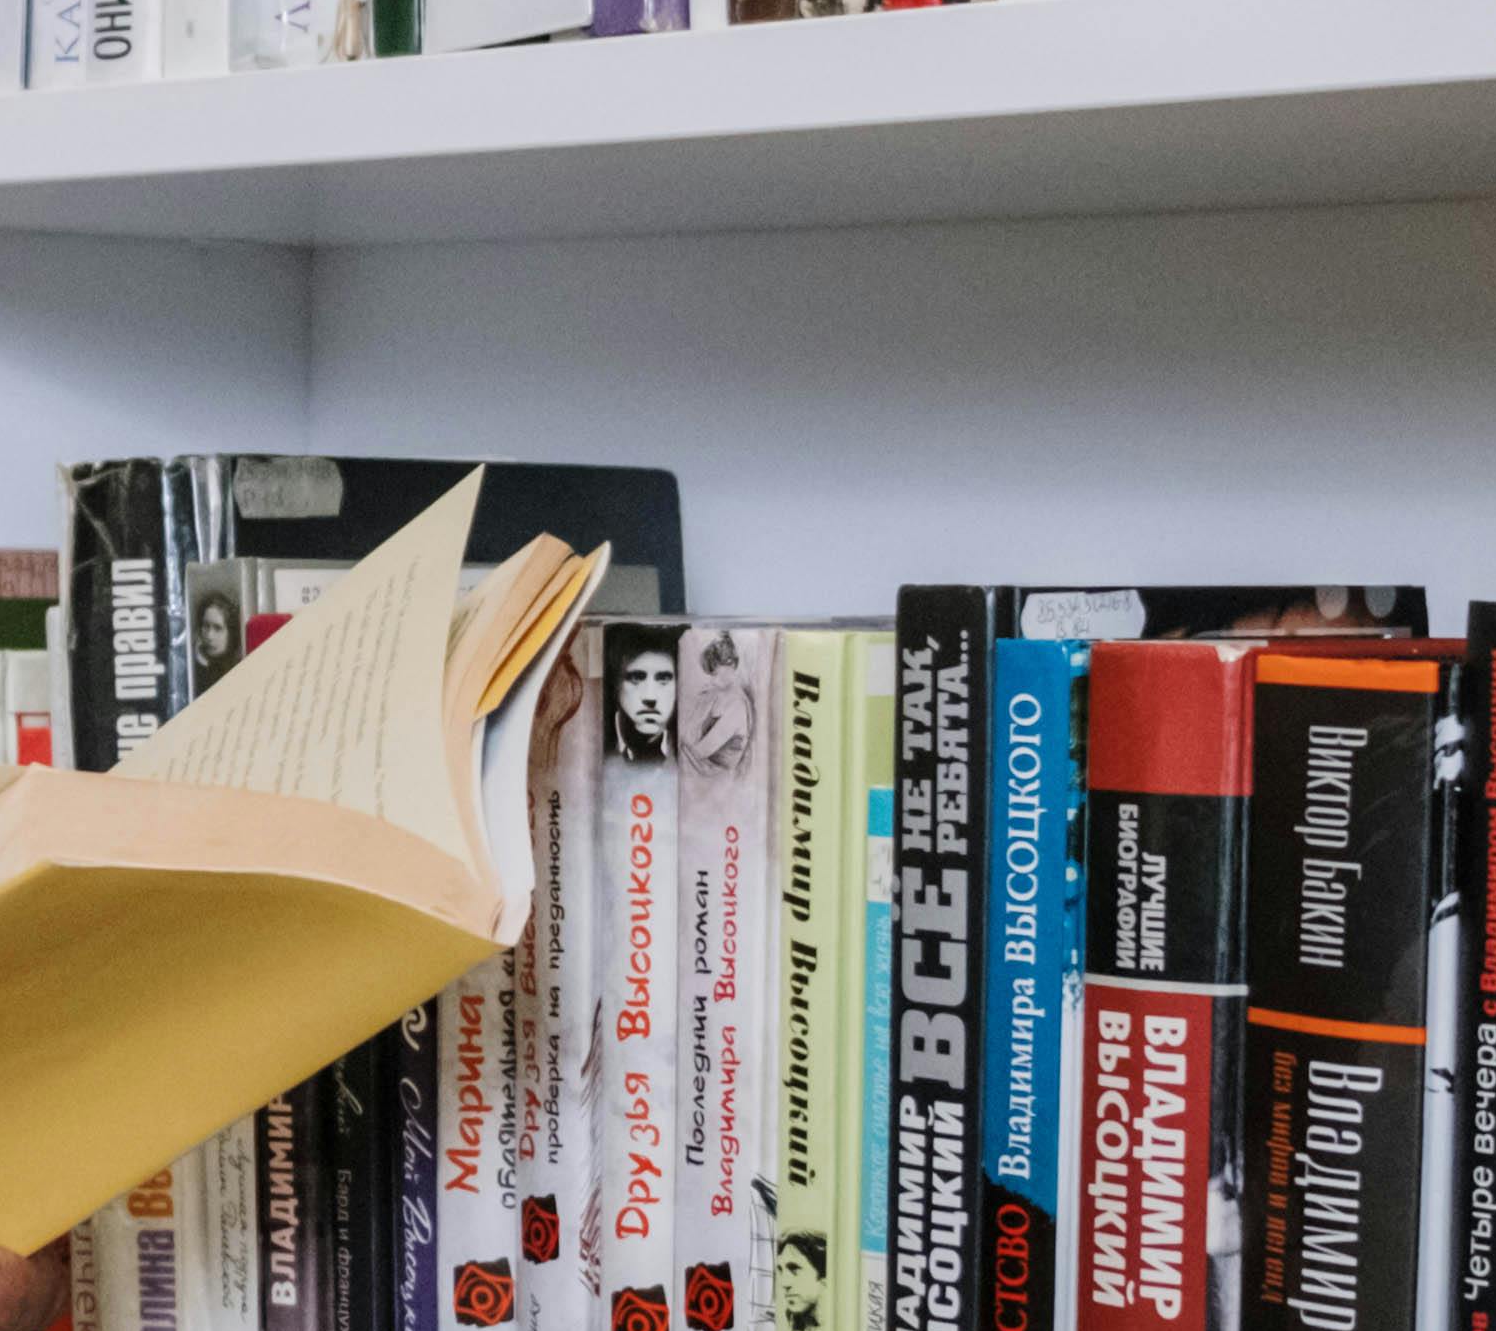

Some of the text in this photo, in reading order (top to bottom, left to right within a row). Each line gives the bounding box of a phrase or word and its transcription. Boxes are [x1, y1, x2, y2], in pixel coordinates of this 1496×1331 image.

[112, 559, 166, 701] правил
[935, 628, 970, 856] РЕБЯТА...
[782, 670, 822, 1187] Владимир Высоцкий
[1114, 803, 1140, 971] БИОГРАФИИ
[1140, 851, 1167, 973] ЛУЧШИЕ
[444, 994, 492, 1195] Марина
[615, 792, 663, 1240] Друзья Высоцкого
[1133, 1014, 1189, 1321] ВЛАДИМИР
